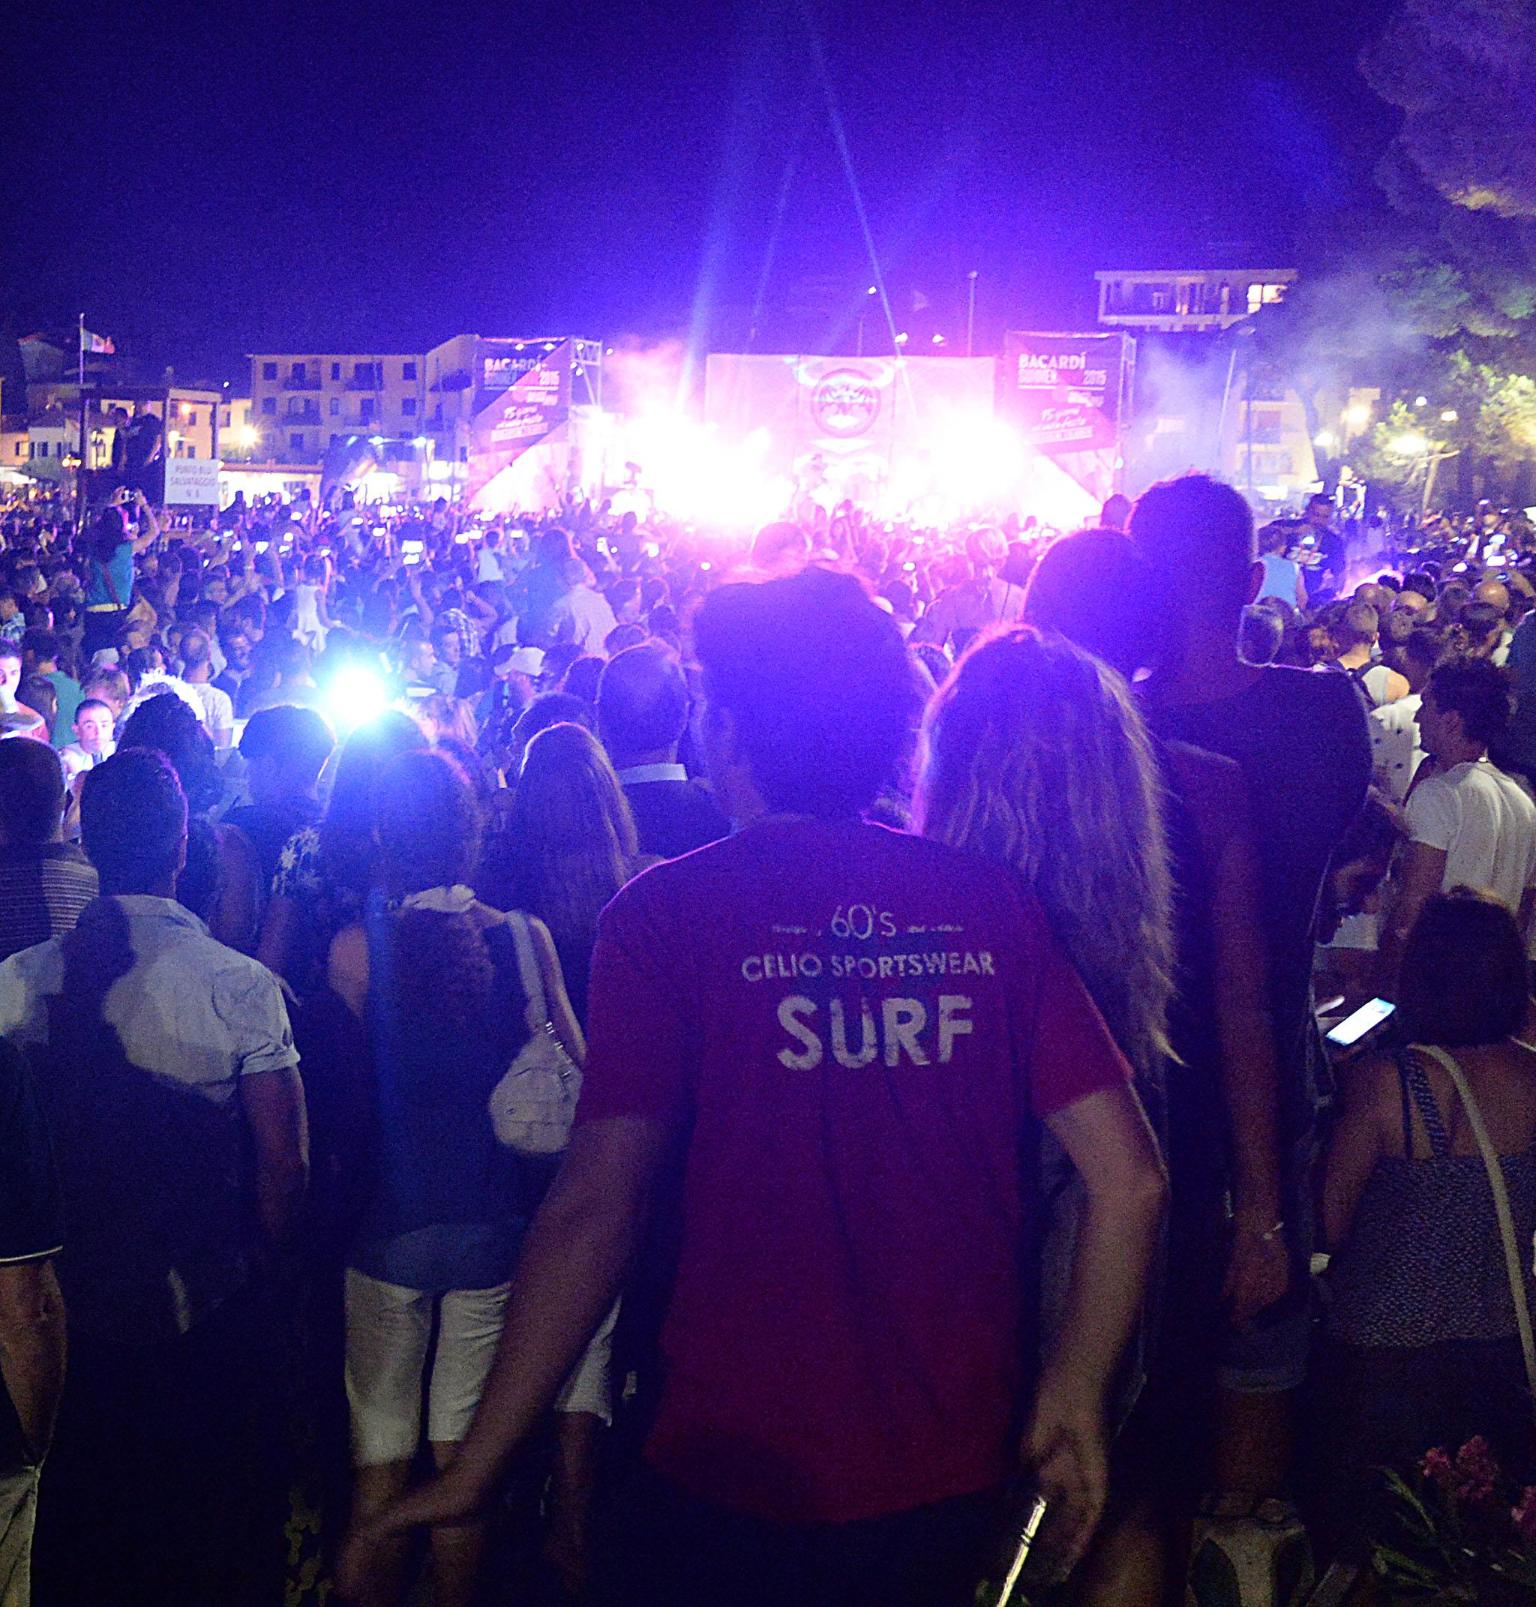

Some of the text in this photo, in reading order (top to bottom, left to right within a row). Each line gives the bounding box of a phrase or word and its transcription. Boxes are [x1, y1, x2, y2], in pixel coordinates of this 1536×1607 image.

[1019, 351, 1086, 369] BACARDÍ
[741, 951, 996, 982] CELIO SPORTSWEAR
[776, 995, 974, 1072] SURF
